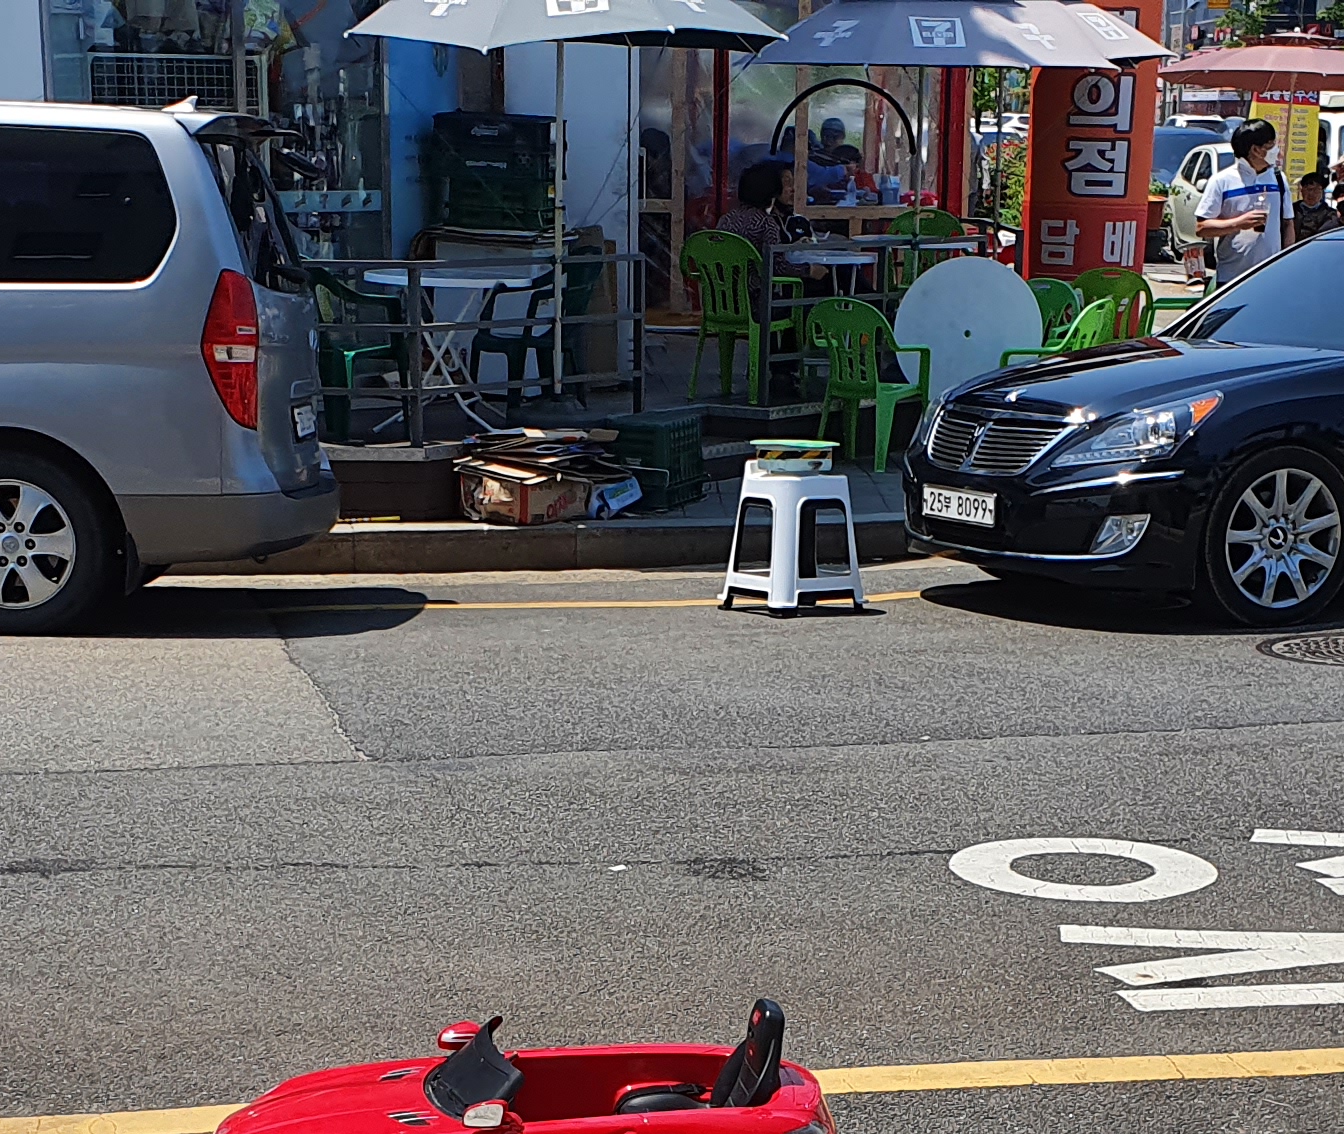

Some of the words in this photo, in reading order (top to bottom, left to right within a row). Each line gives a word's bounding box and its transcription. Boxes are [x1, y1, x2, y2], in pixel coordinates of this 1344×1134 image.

[1064, 10, 1136, 196] 의점
[1040, 219, 1137, 267] 담배
[929, 491, 952, 513] 25부
[956, 496, 988, 520] 8099
